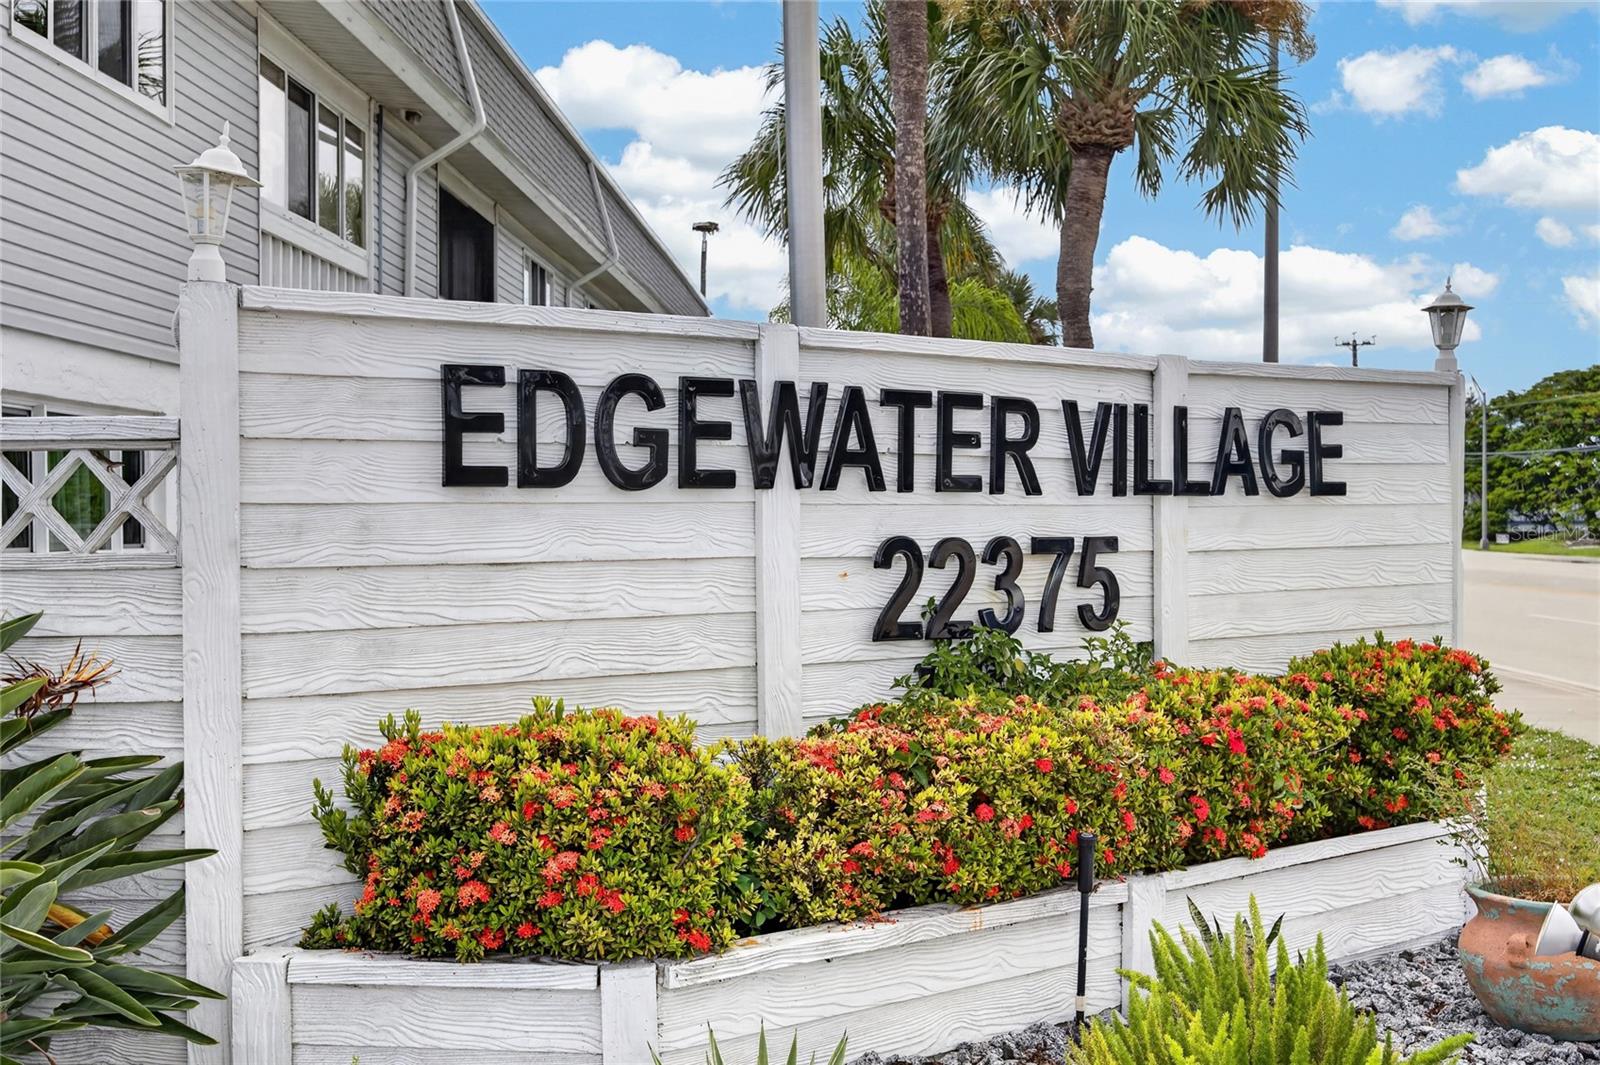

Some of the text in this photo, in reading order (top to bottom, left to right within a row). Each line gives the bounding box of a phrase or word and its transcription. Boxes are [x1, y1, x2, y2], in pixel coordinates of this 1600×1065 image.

[441, 364, 1348, 497] EDGEWATER VILLAGE
[872, 536, 1119, 642] 22375
